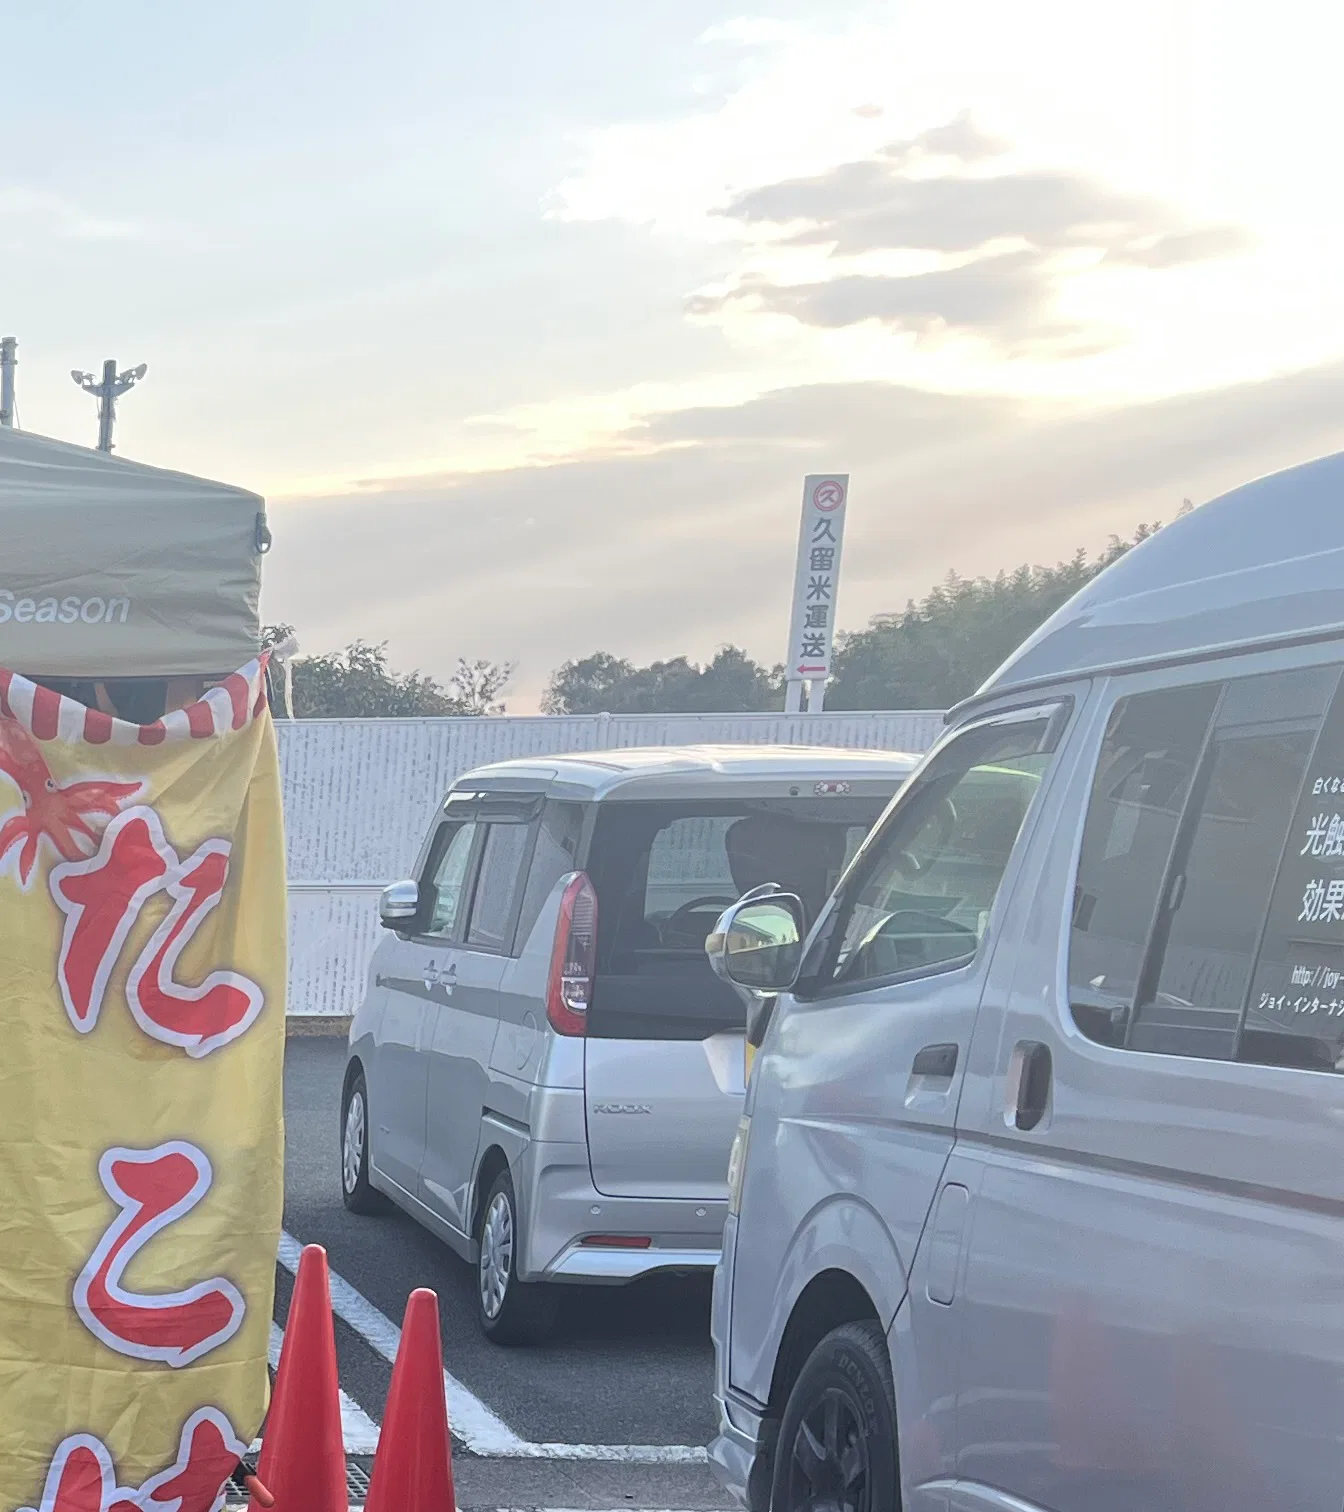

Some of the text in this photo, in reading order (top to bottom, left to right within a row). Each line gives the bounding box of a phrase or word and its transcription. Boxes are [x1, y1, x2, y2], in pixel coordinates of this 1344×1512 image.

[800, 517, 837, 659] 久留米運送
[593, 1104, 653, 1115] ROOX
